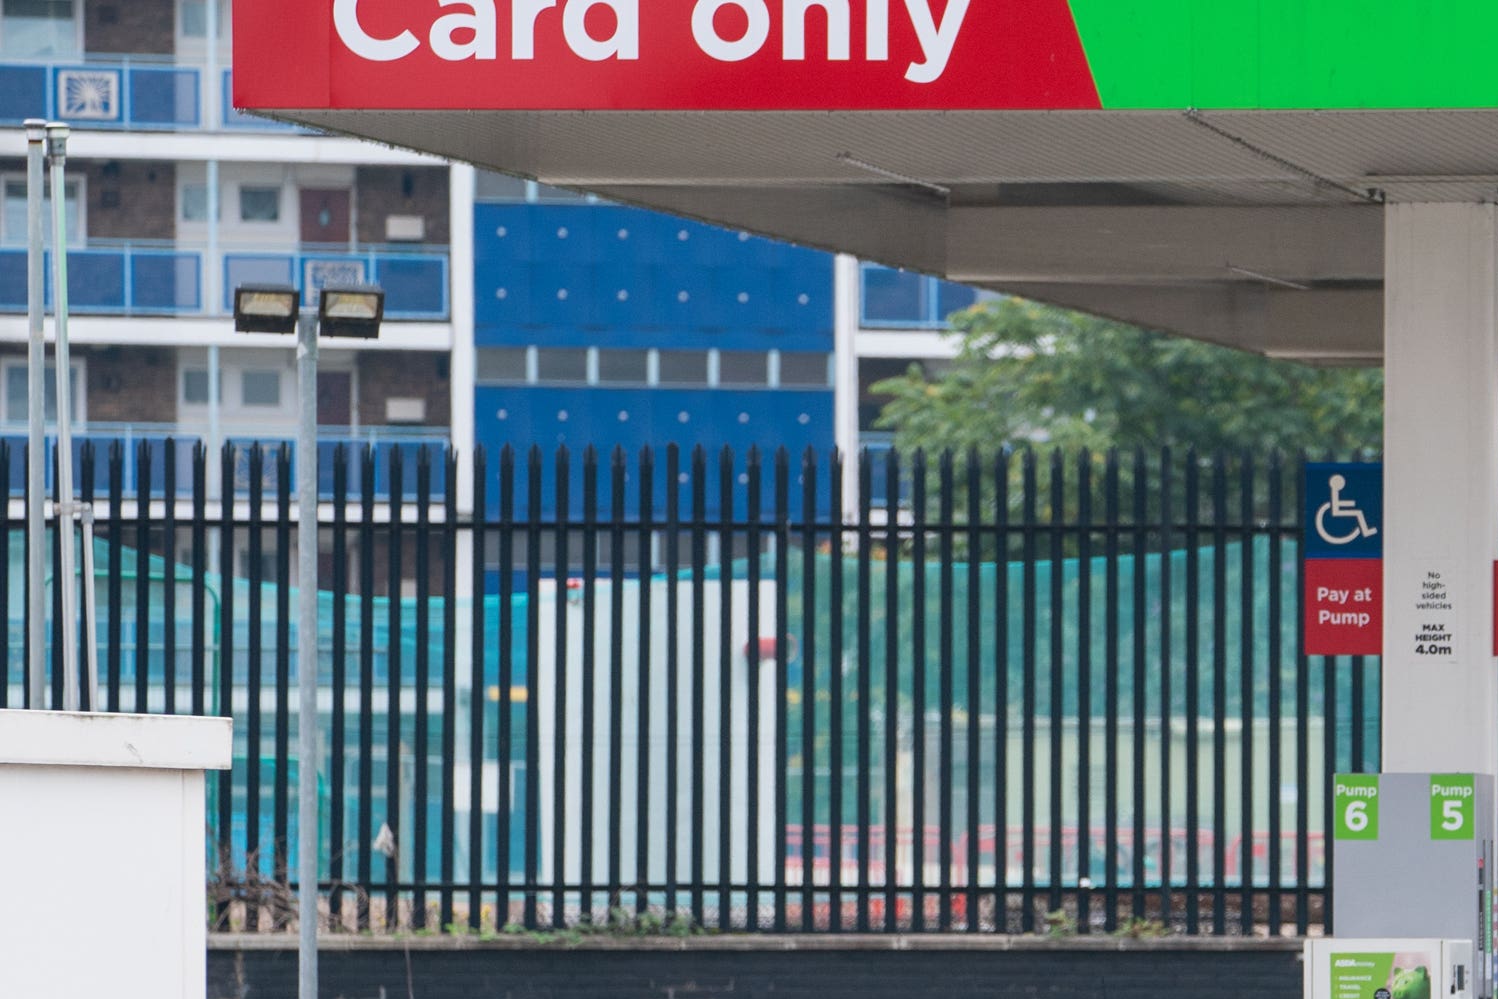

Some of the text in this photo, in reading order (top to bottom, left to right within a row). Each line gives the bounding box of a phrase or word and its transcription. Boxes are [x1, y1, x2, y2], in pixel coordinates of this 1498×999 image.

[332, 0, 972, 84] Card only
[1427, 571, 1441, 579] No
[1422, 581, 1446, 590] high-
[1317, 587, 1372, 603] Pay at
[1318, 610, 1370, 627] Pump
[1415, 644, 1452, 655] 4.0m
[1336, 784, 1377, 798] Pump
[1431, 784, 1473, 798] Pump
[1344, 800, 1369, 832] 6
[1441, 800, 1464, 832] 5
